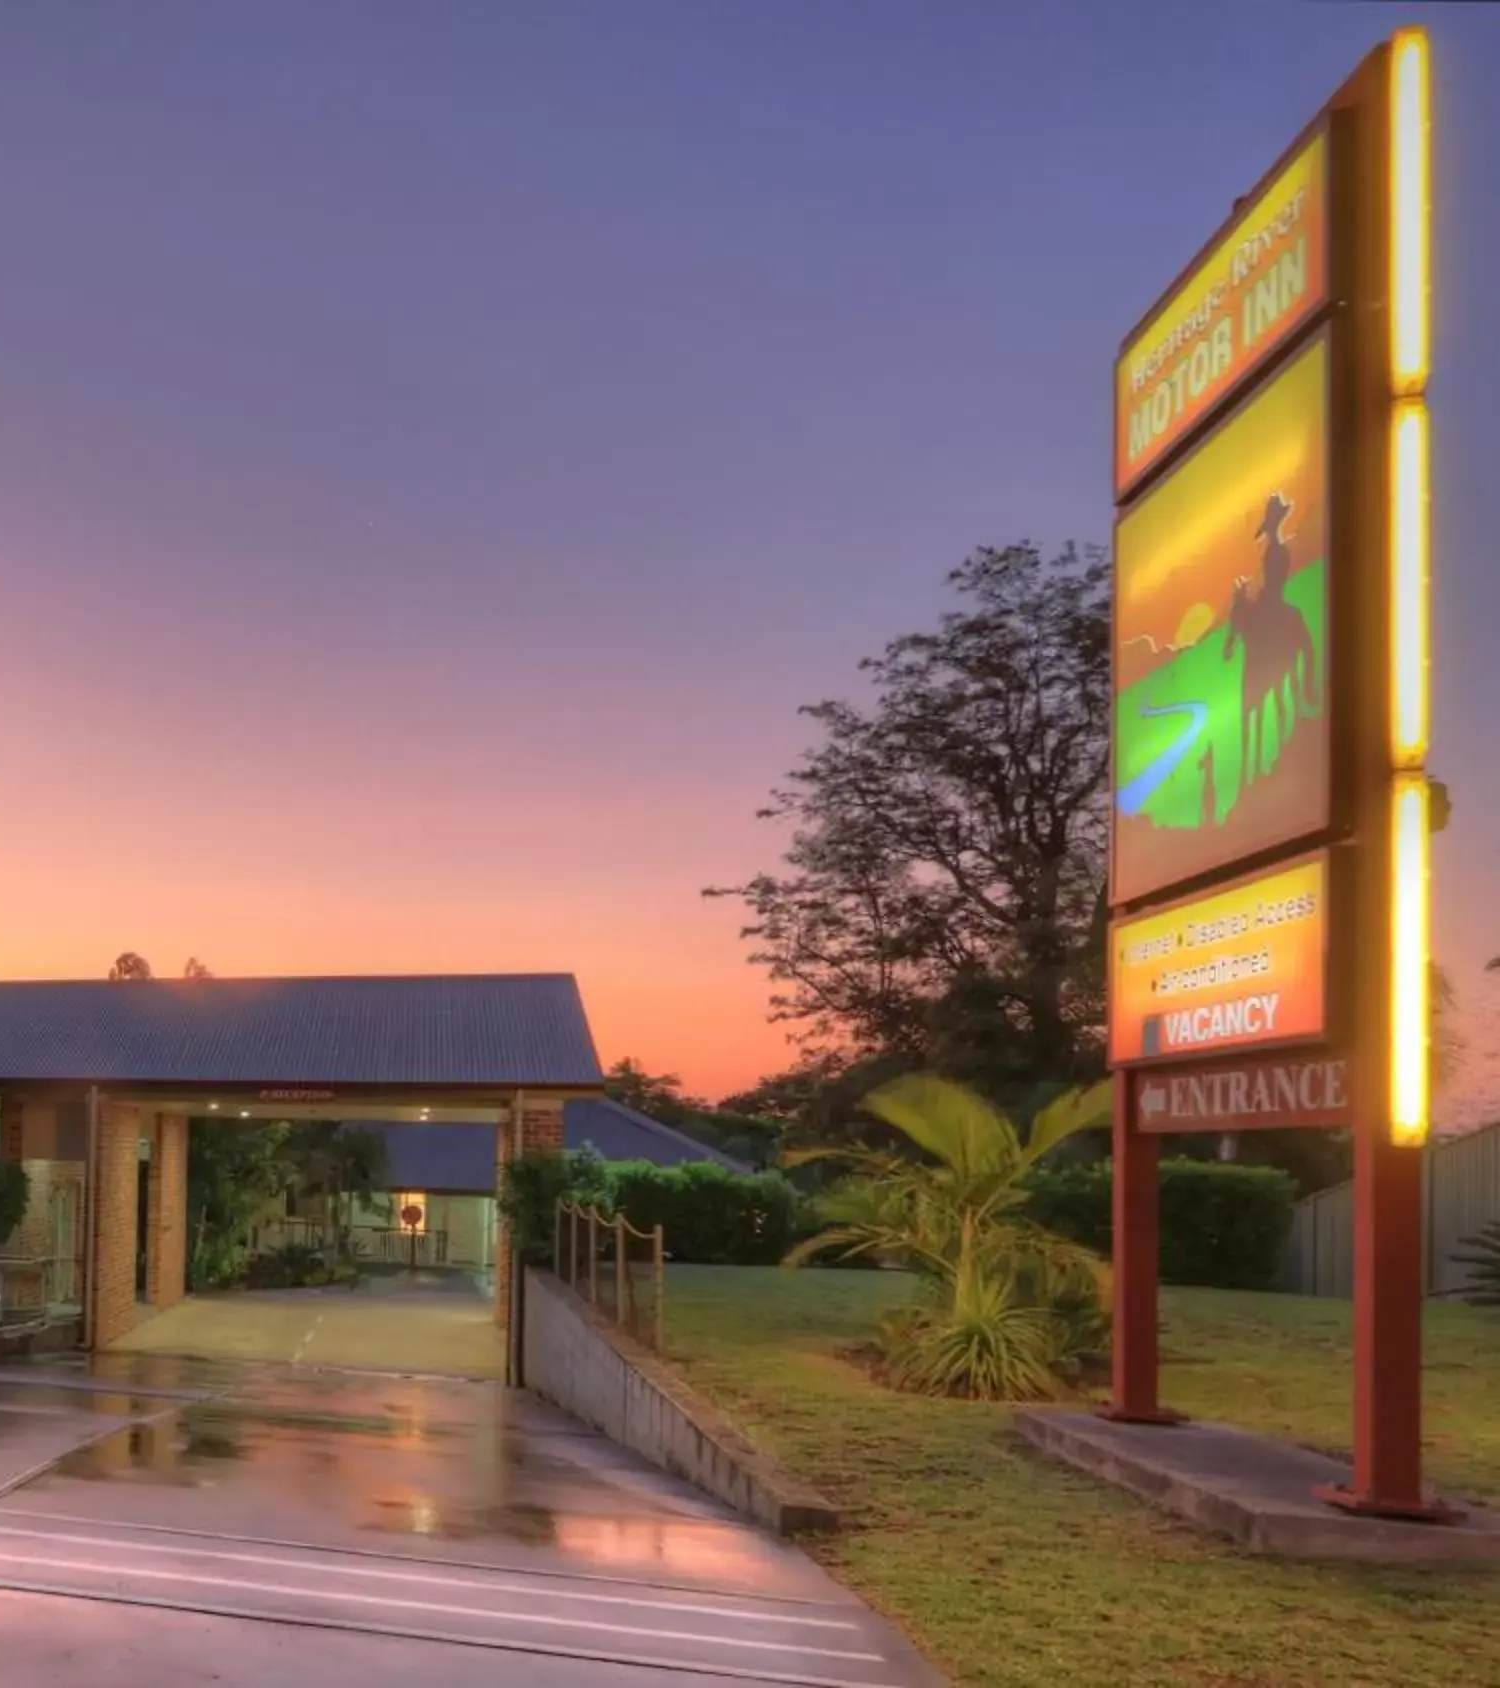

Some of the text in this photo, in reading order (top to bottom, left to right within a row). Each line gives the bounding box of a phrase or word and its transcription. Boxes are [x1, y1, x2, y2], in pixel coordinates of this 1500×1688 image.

[1129, 237, 1306, 463] MOTOR INN
[1257, 893, 1315, 924] Access
[1165, 995, 1278, 1044] VACANCY
[1171, 1061, 1346, 1116] ENTRANCE
